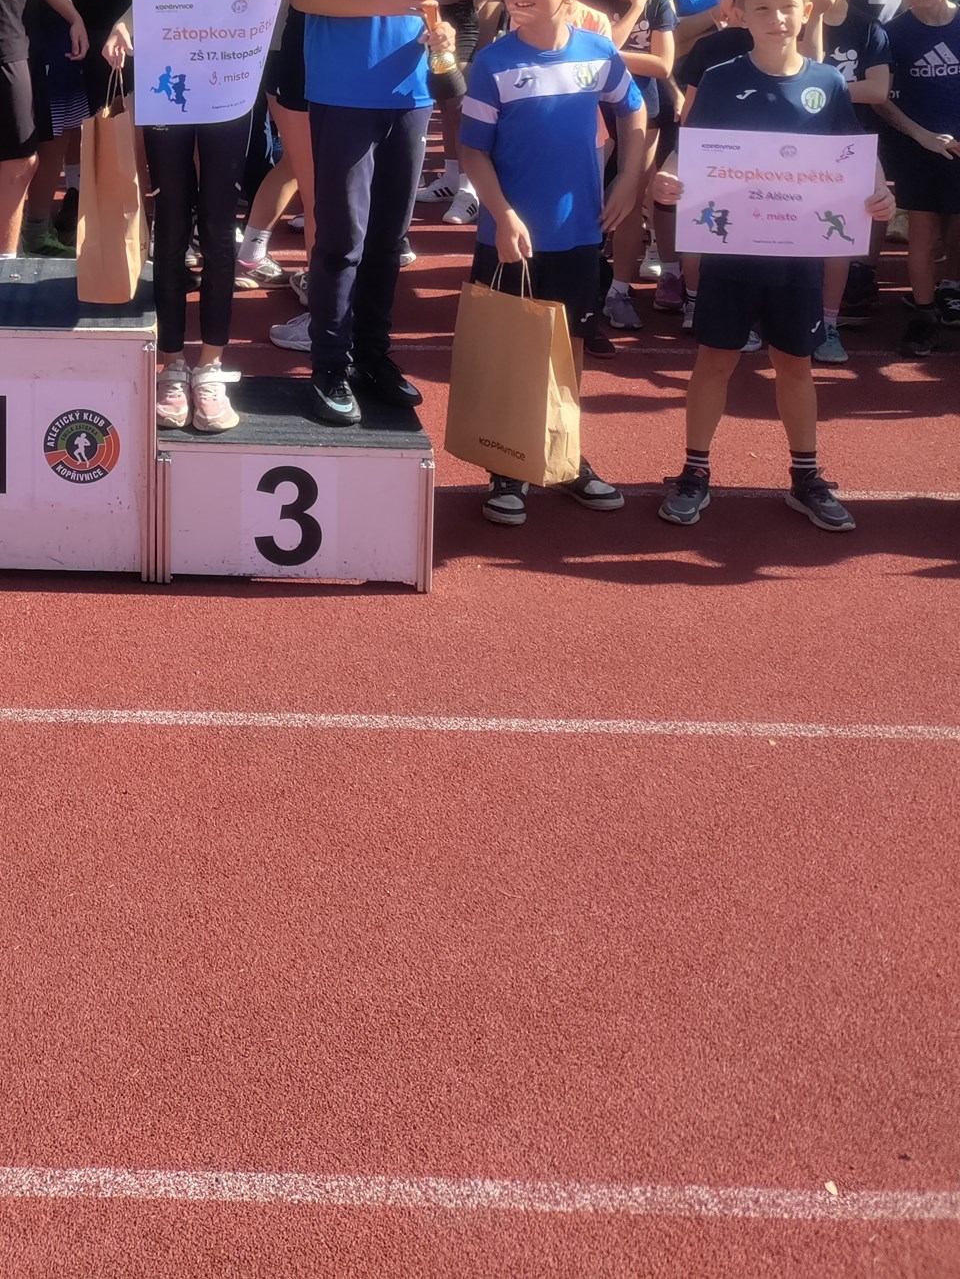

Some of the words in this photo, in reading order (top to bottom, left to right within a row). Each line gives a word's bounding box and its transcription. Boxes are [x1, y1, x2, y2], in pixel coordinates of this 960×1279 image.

[161, 26, 246, 42] Zátopkova
[190, 49, 204, 61] ZŠ
[206, 51, 219, 61] 17.
[706, 165, 793, 184] Zátopkova
[796, 168, 845, 185] pětka
[748, 189, 764, 201] ZŠ
[47, 410, 81, 447] ATLETICKÝ
[83, 412, 106, 427] KLUB
[55, 464, 104, 482] KOPŘIVNICE
[255, 466, 323, 567] 3
